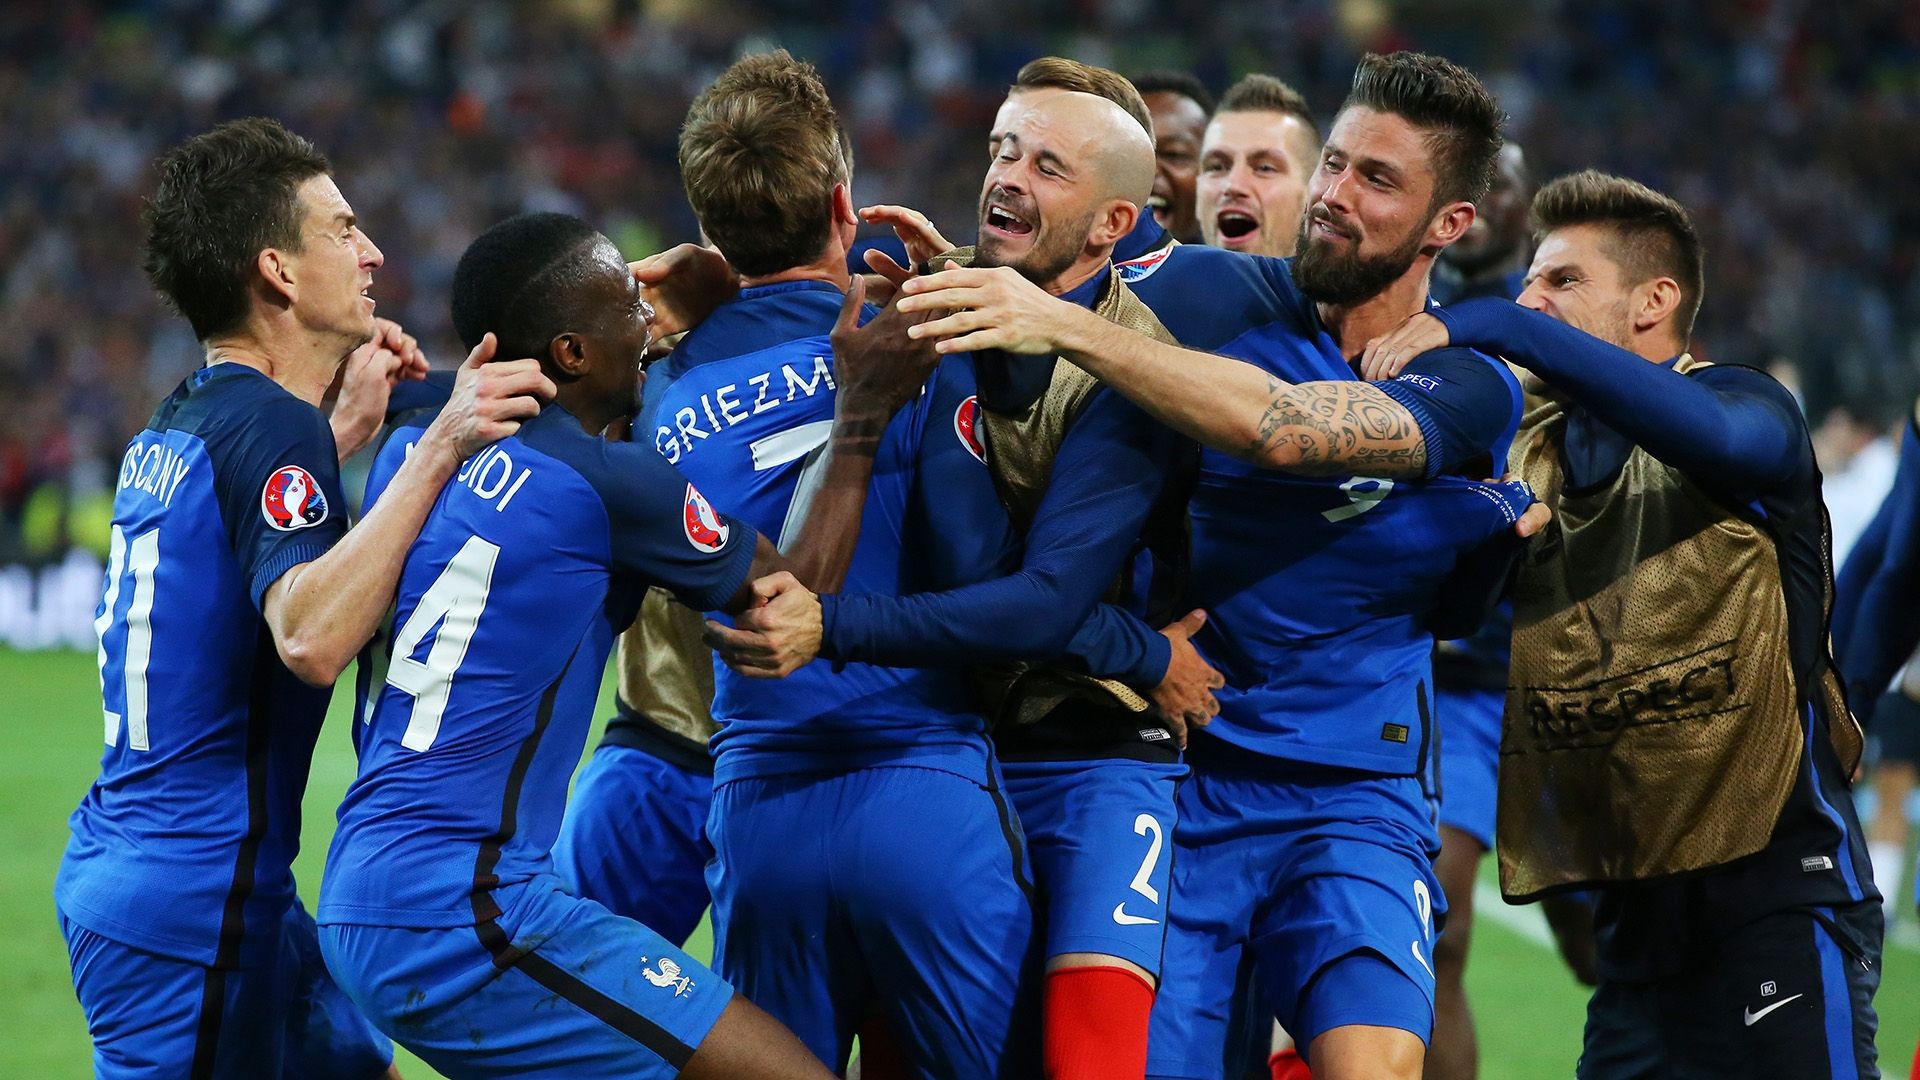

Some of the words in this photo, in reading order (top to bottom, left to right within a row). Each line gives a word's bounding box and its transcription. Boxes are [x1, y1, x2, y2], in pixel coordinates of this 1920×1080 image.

[656, 356, 836, 465] GRIEZM
[1396, 373, 1440, 391] SPECT
[1321, 476, 1395, 523] 9
[1530, 655, 1739, 736] RESPECT
[1129, 813, 1162, 905] 2
